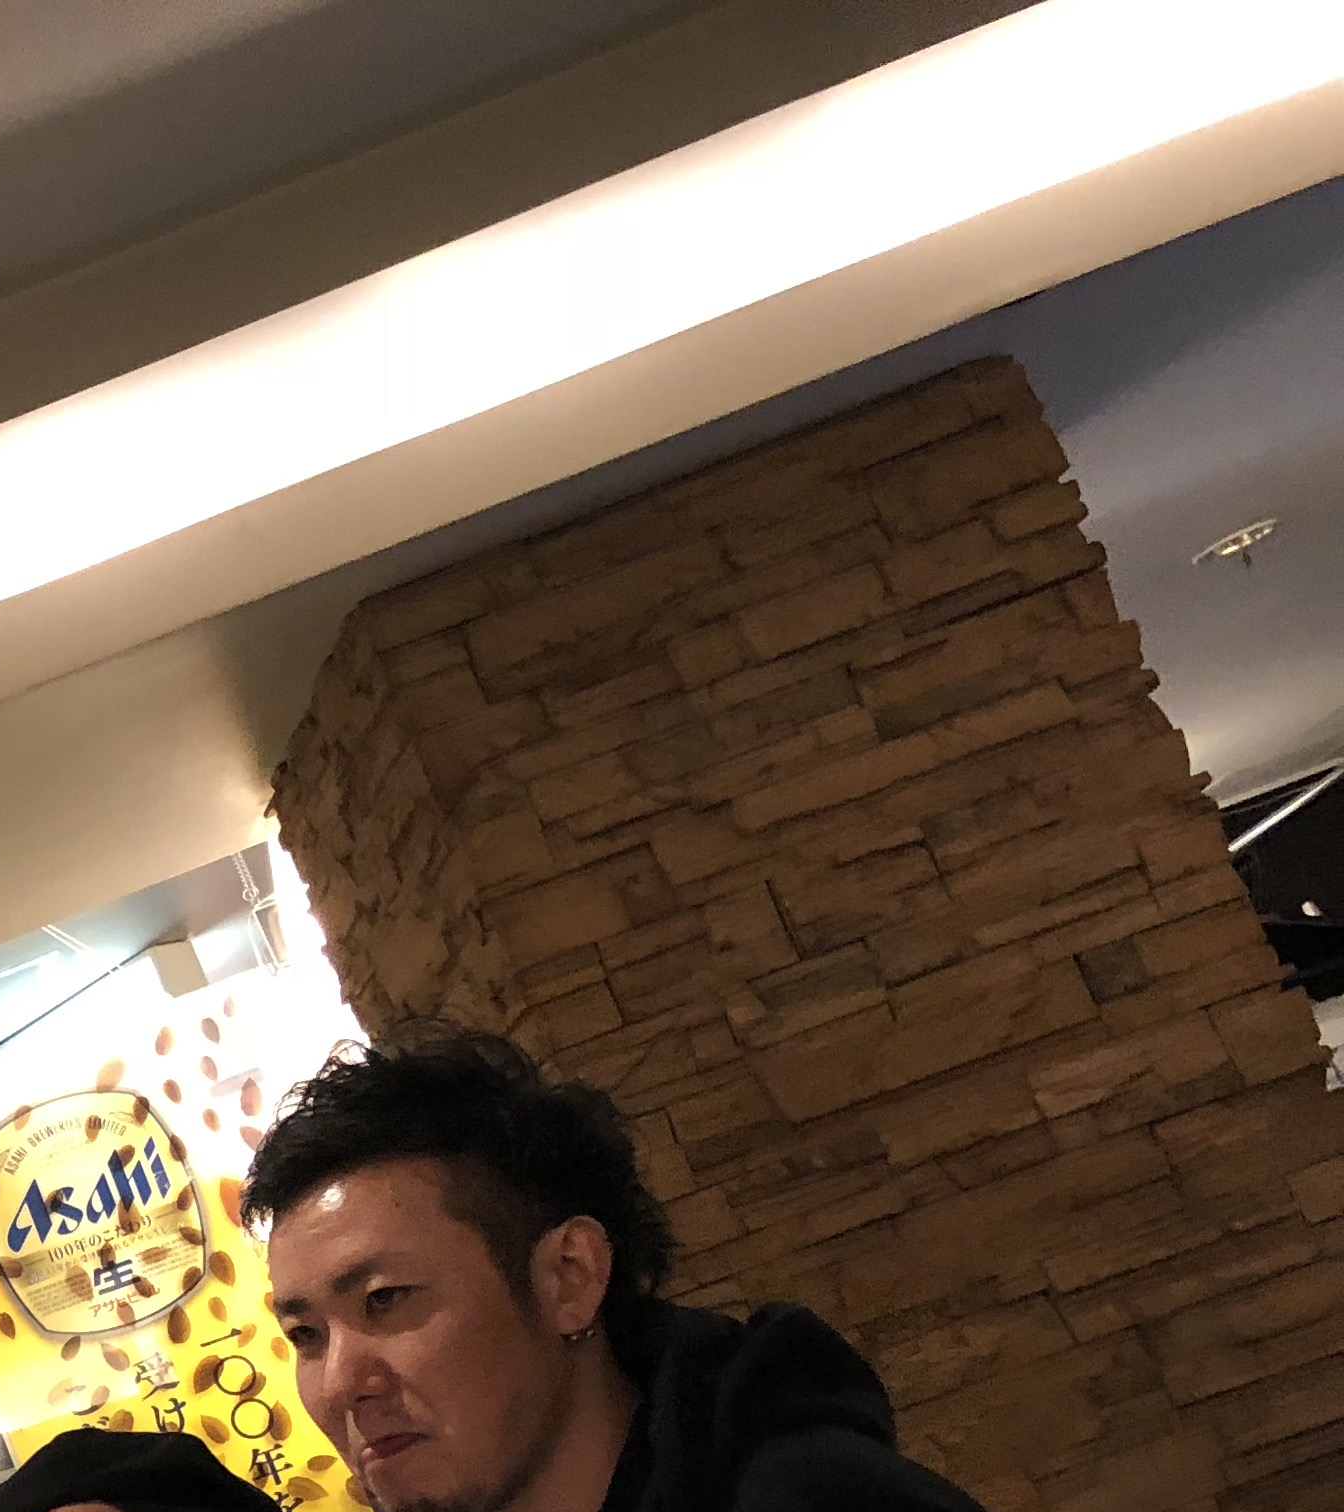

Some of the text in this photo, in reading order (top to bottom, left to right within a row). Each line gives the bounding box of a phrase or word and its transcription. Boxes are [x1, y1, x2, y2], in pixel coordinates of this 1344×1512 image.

[4, 1116, 127, 1175] ASAHI BREWERIES LIMITED
[7, 1136, 172, 1254] Asahi
[93, 1258, 141, 1296] 生
